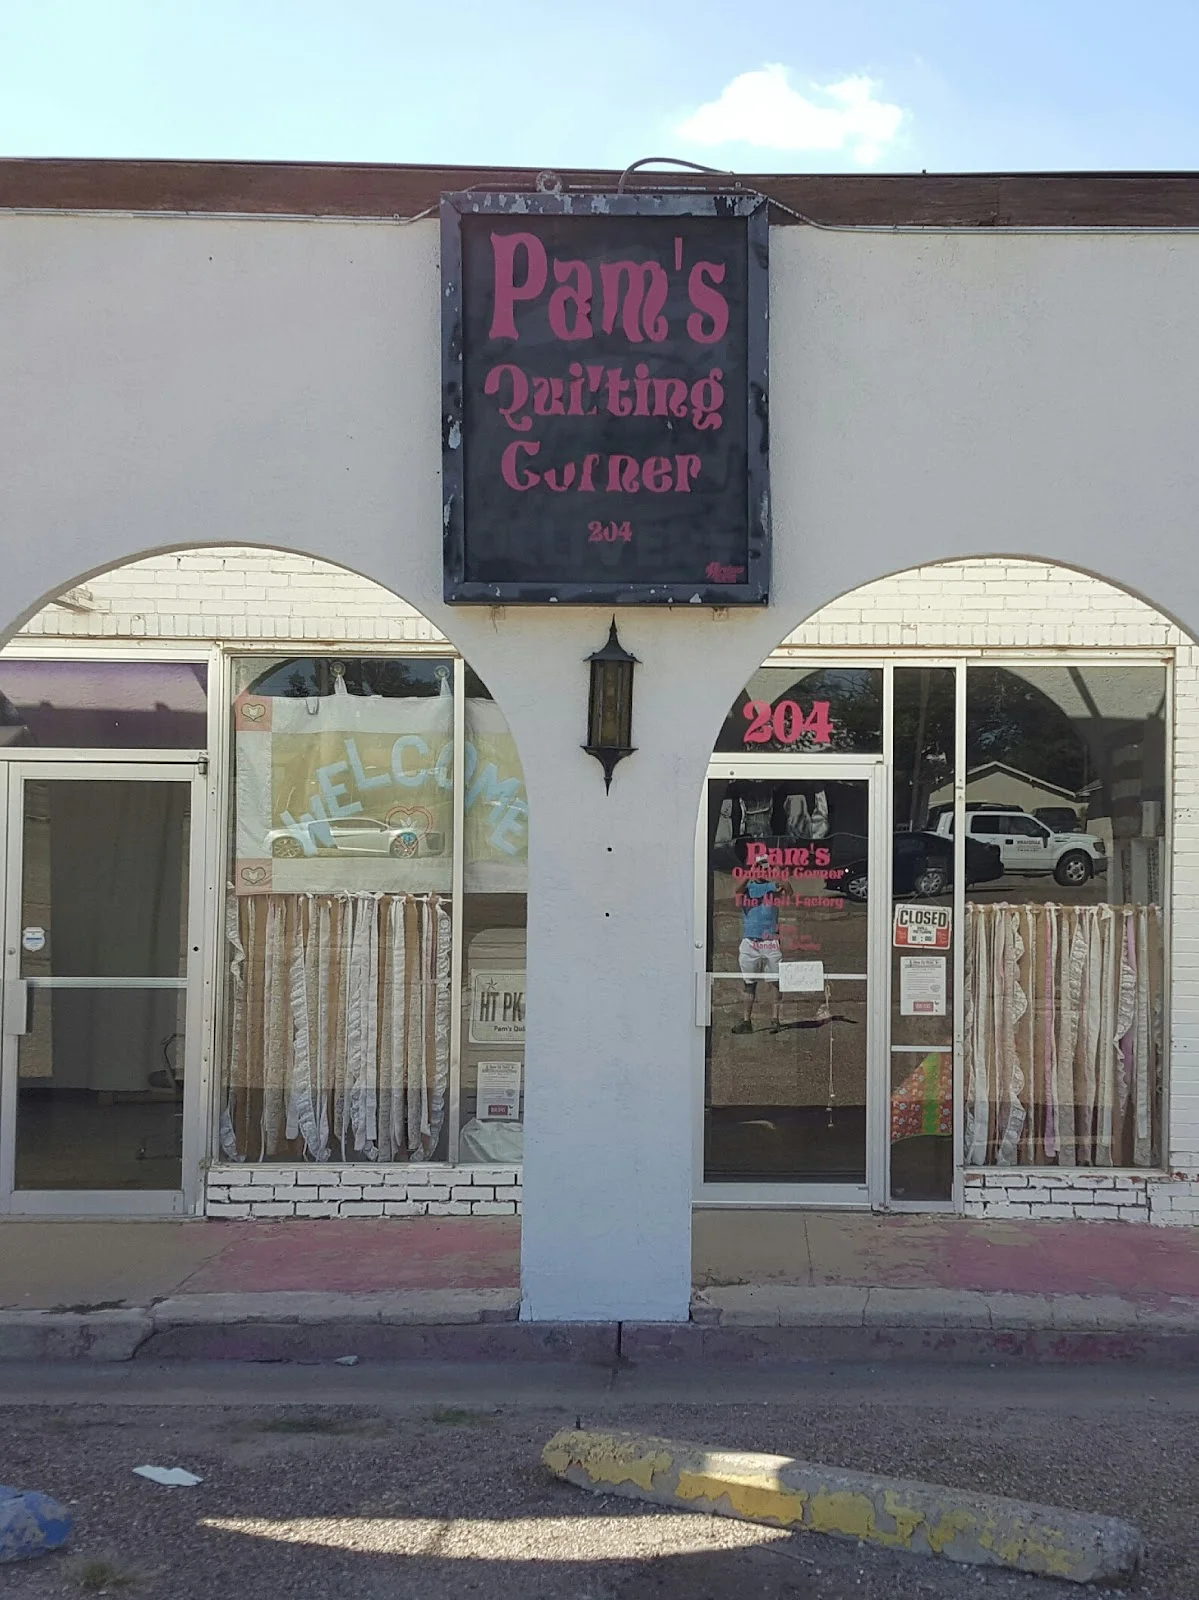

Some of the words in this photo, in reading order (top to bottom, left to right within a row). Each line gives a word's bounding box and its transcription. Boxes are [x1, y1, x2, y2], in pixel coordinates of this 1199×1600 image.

[489, 232, 729, 344] Pam's
[588, 521, 632, 542] 204
[742, 700, 834, 745] 204
[279, 734, 528, 857] WELCOME
[746, 841, 831, 867] Pam's
[793, 866, 845, 880] Corner
[735, 893, 758, 907] The
[795, 892, 845, 910] Factory
[899, 910, 946, 927] CLOSED
[480, 991, 500, 1022] HT
